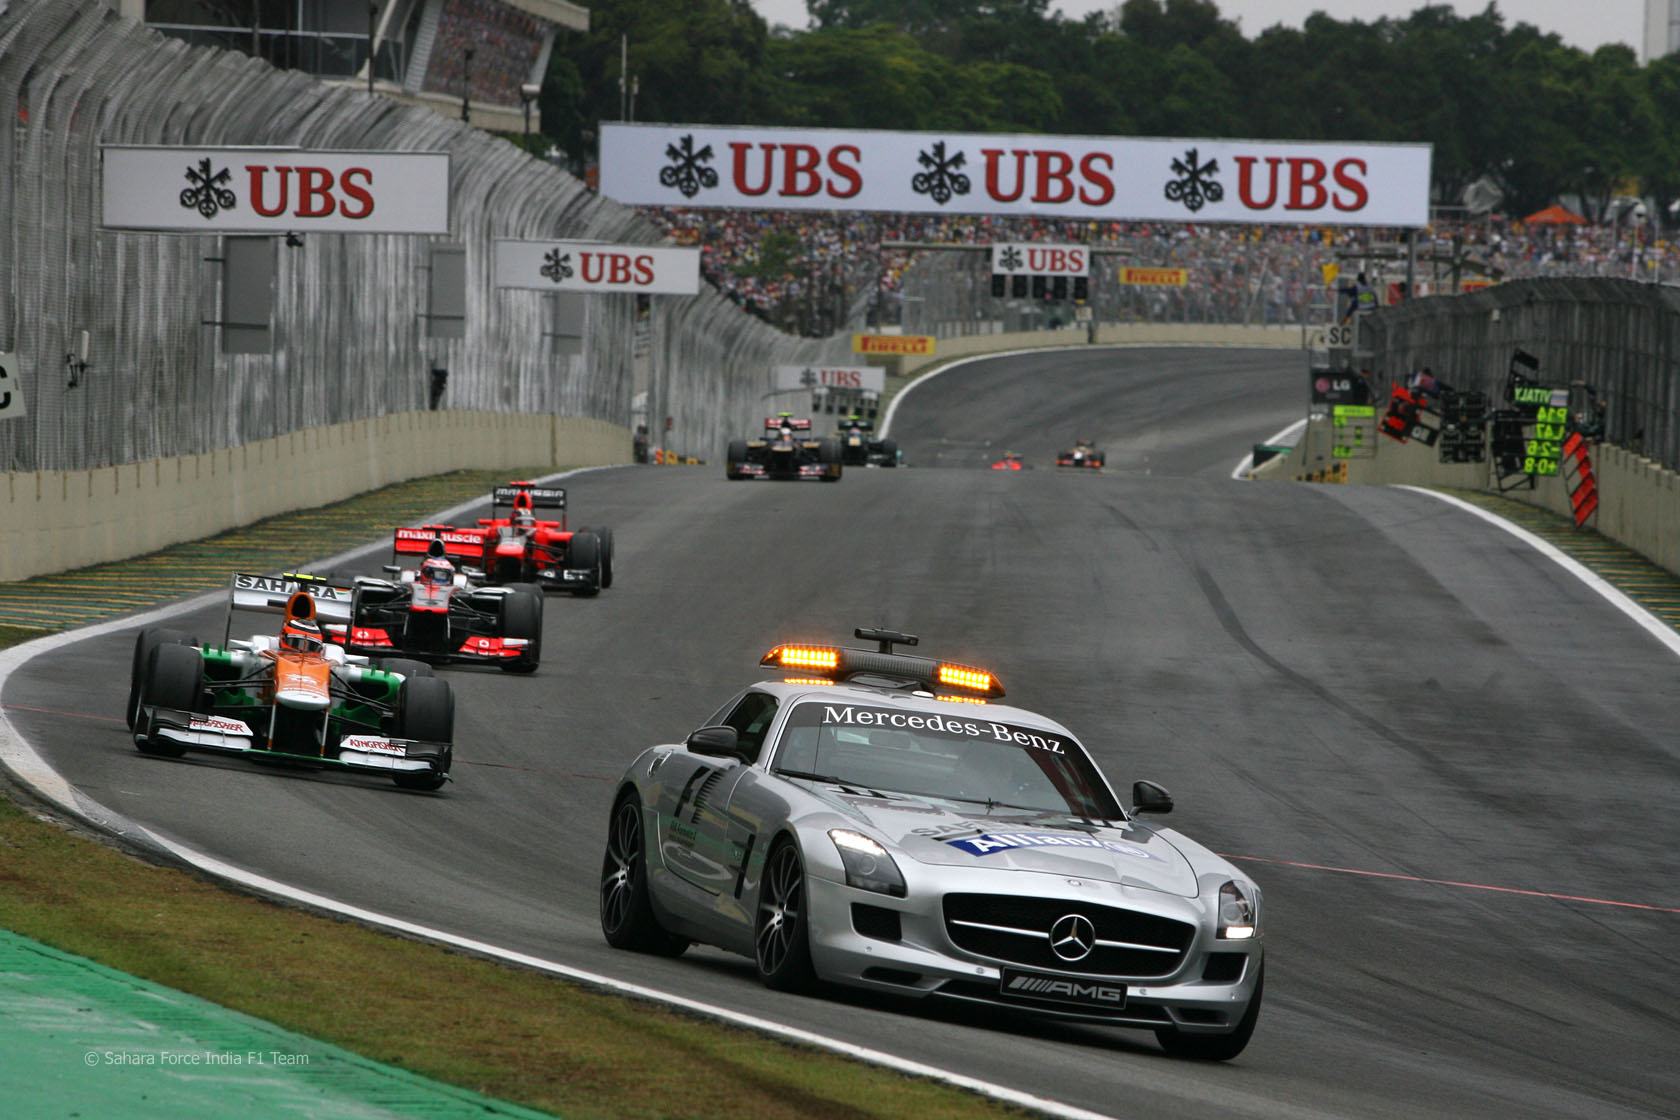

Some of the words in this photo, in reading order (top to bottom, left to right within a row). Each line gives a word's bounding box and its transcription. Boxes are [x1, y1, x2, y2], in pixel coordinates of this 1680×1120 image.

[730, 143, 862, 197] UBS
[982, 149, 1114, 205] UBS
[1234, 157, 1368, 211] UBS
[245, 165, 374, 218] UBS
[581, 252, 654, 285] UBS
[1029, 248, 1083, 272] UBS
[1329, 326, 1352, 344] SC
[821, 370, 862, 387] UBS
[1332, 379, 1351, 391] LG
[822, 706, 1066, 755] Mercedes-Benz
[965, 833, 1103, 853] Allianz
[1045, 980, 1122, 1002] AMG
